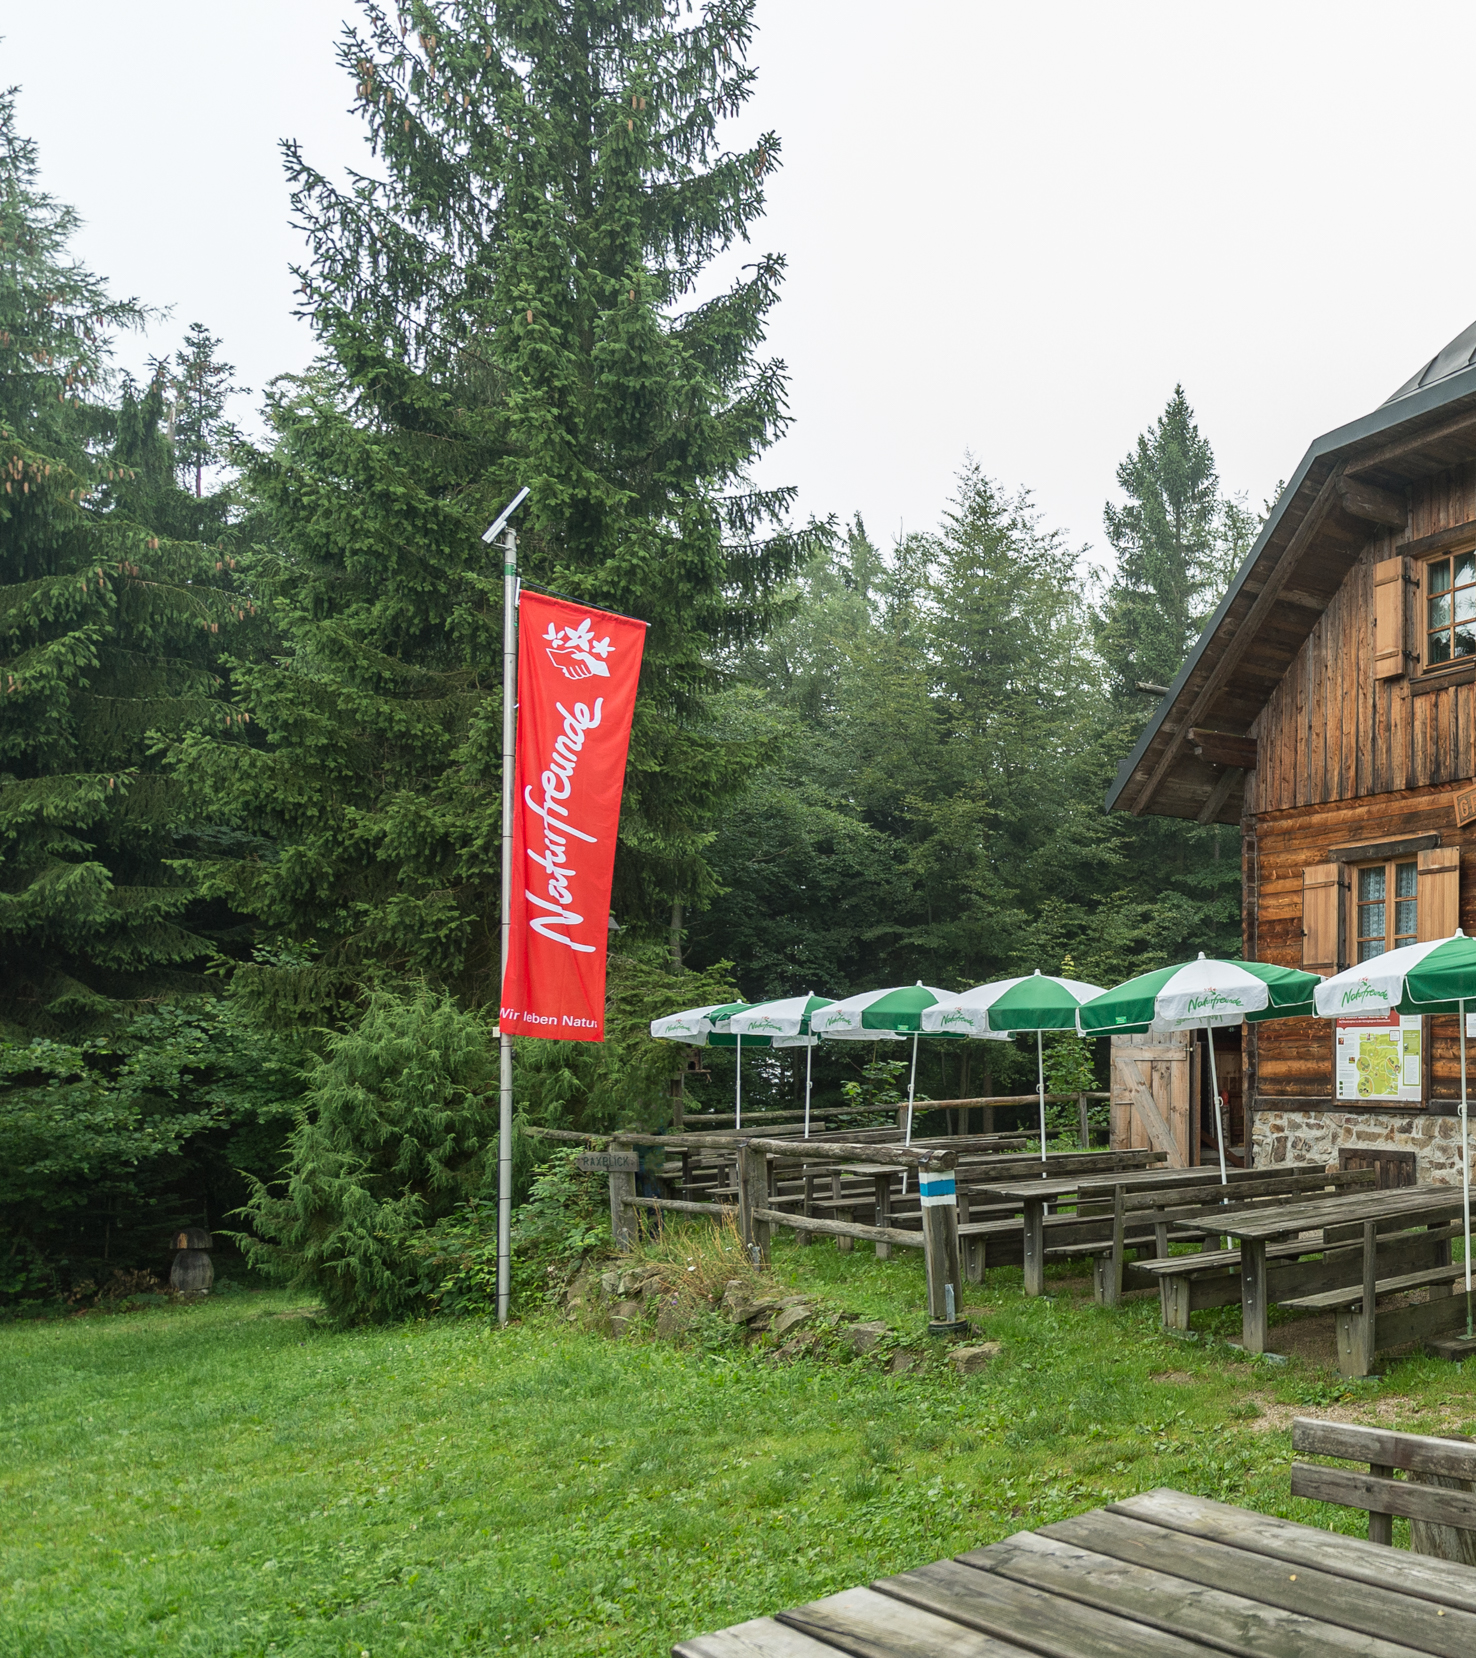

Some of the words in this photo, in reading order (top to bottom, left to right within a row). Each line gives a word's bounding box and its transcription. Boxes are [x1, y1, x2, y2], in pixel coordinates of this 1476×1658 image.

[524, 696, 604, 953] Naturfreunde
[1188, 993, 1244, 1013] Naturfreunde
[1341, 984, 1388, 1008] Naturfreunde
[500, 1007, 520, 1020] Wir
[523, 1011, 558, 1025] leben
[583, 1156, 630, 1167] RAXBLICK
